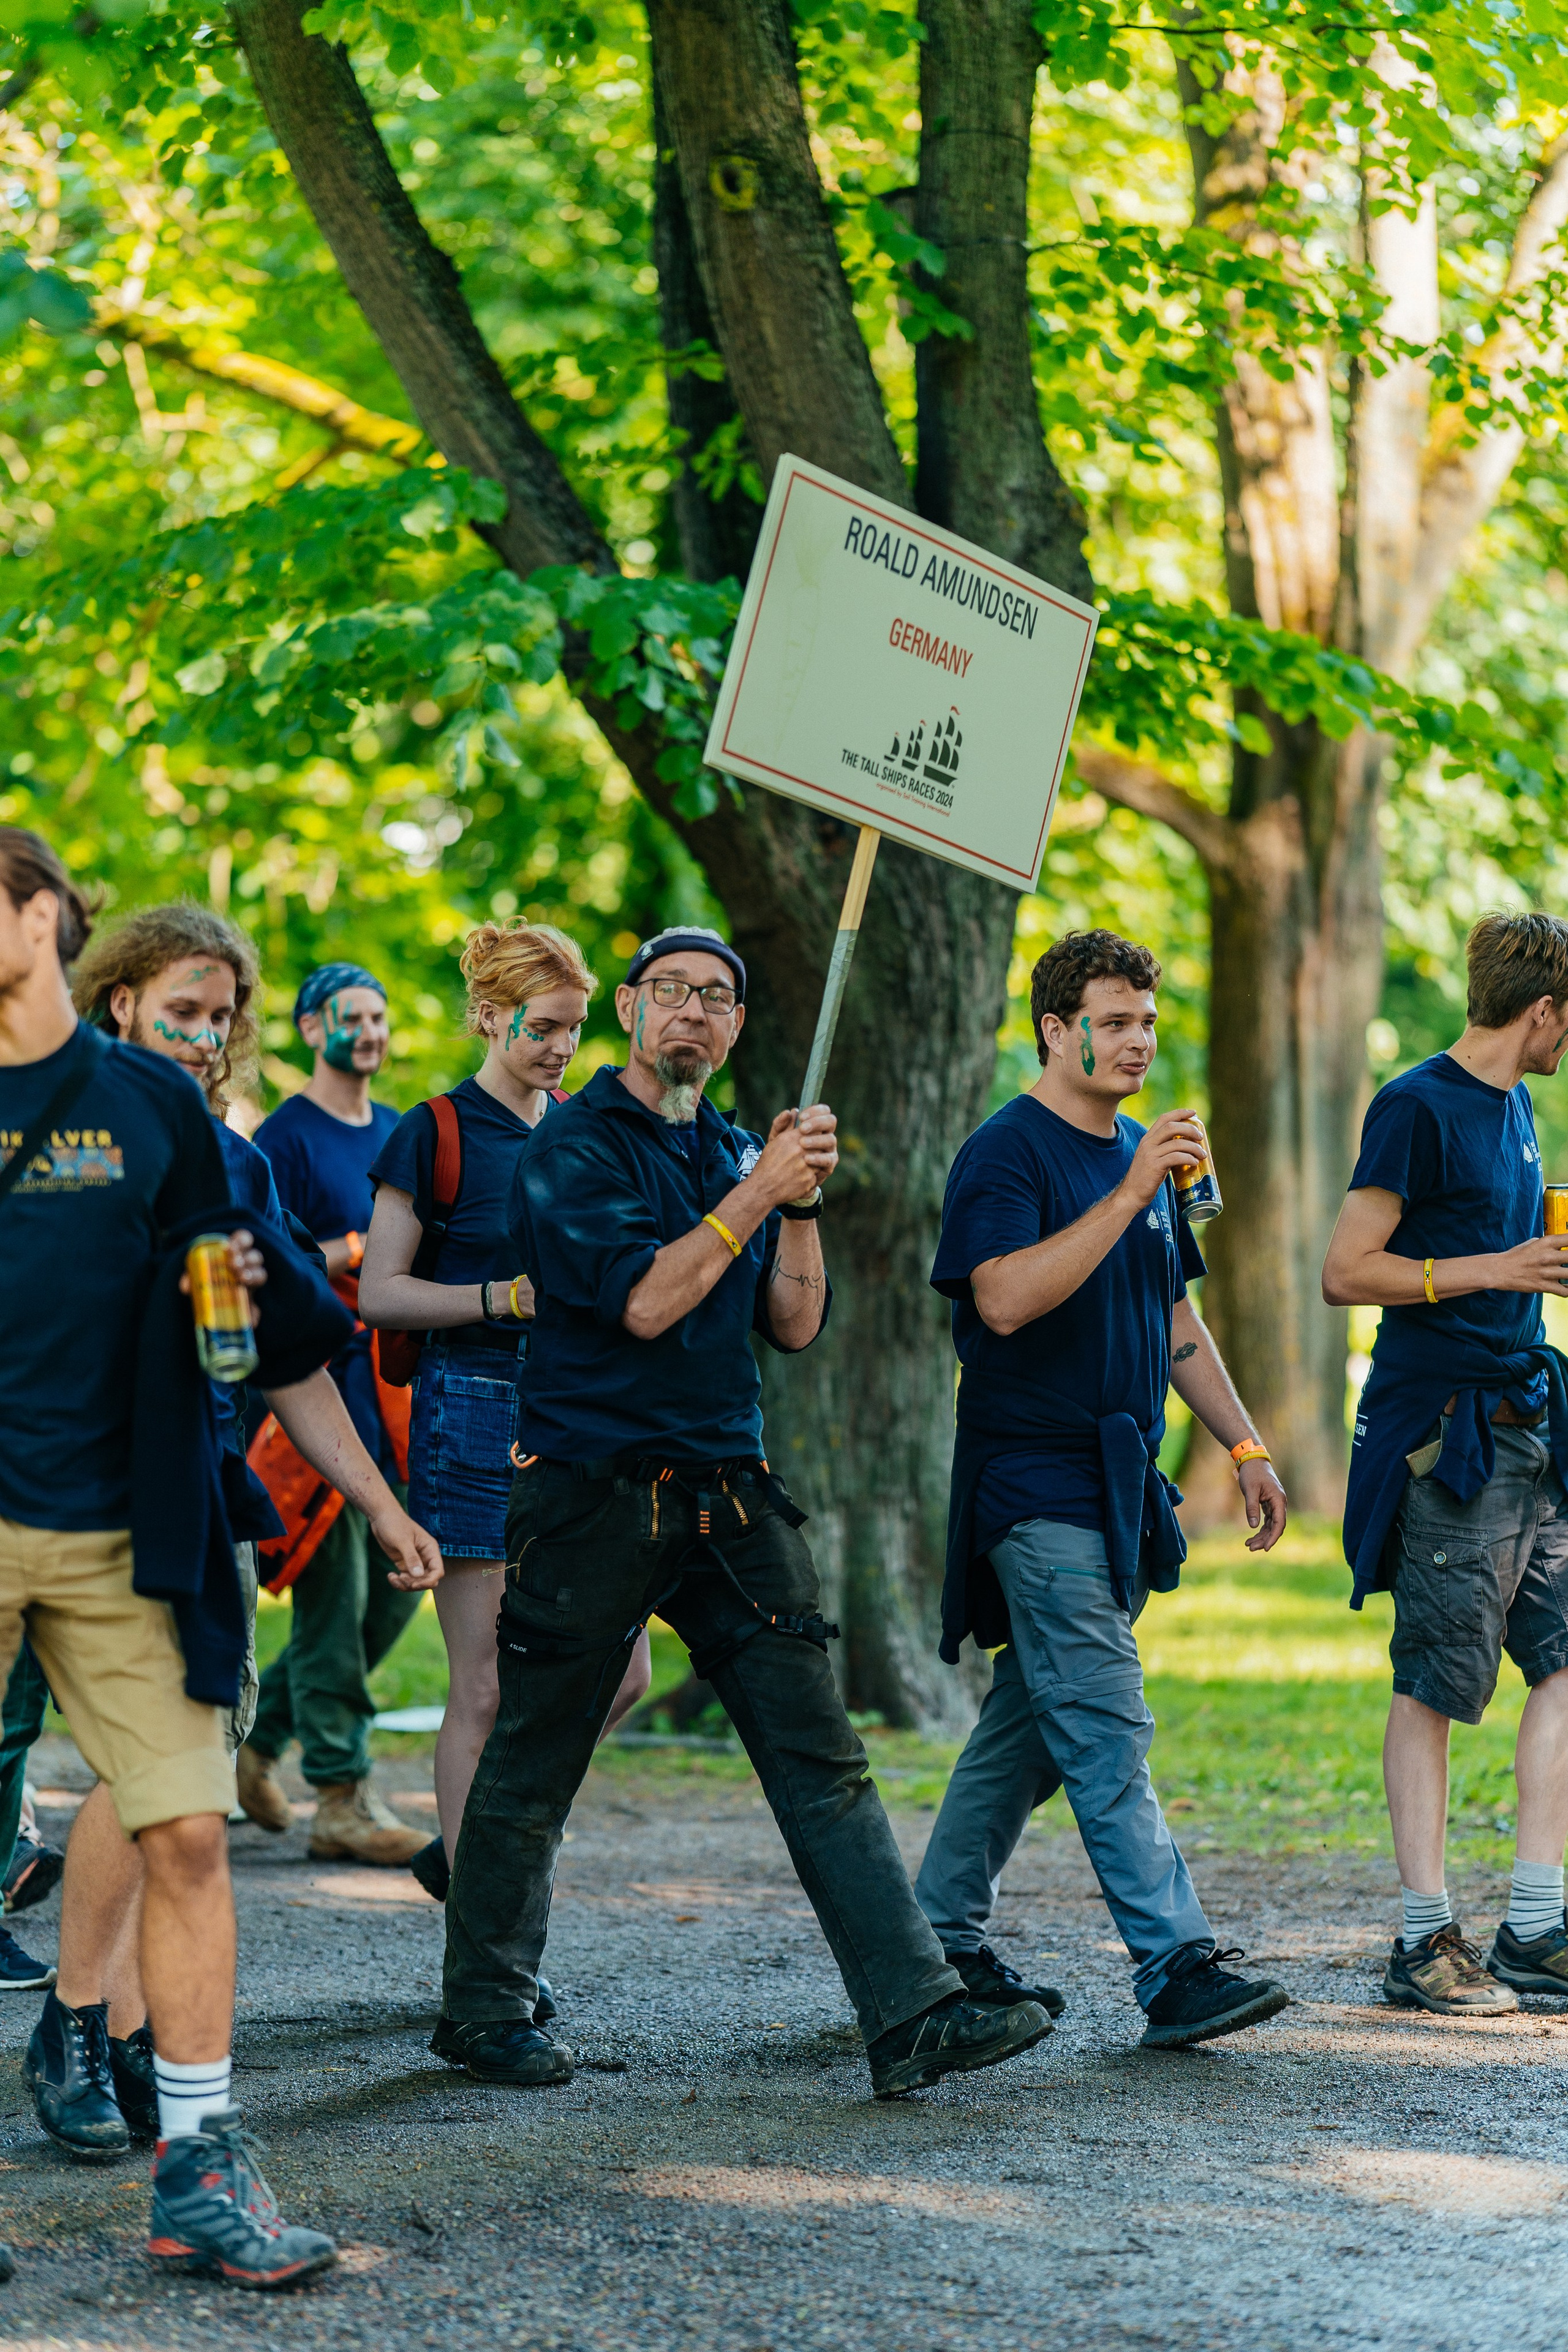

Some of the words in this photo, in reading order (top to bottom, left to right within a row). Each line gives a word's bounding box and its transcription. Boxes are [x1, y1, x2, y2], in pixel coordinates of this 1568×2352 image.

[843, 516, 919, 580] ROALD
[921, 554, 1039, 640] AMUNDSEN
[889, 617, 974, 679] GERMANY
[842, 749, 859, 768] THE
[861, 756, 880, 778] TALL
[881, 766, 907, 789] SHIPS
[908, 778, 935, 801] RACES
[936, 790, 953, 809] 2024
